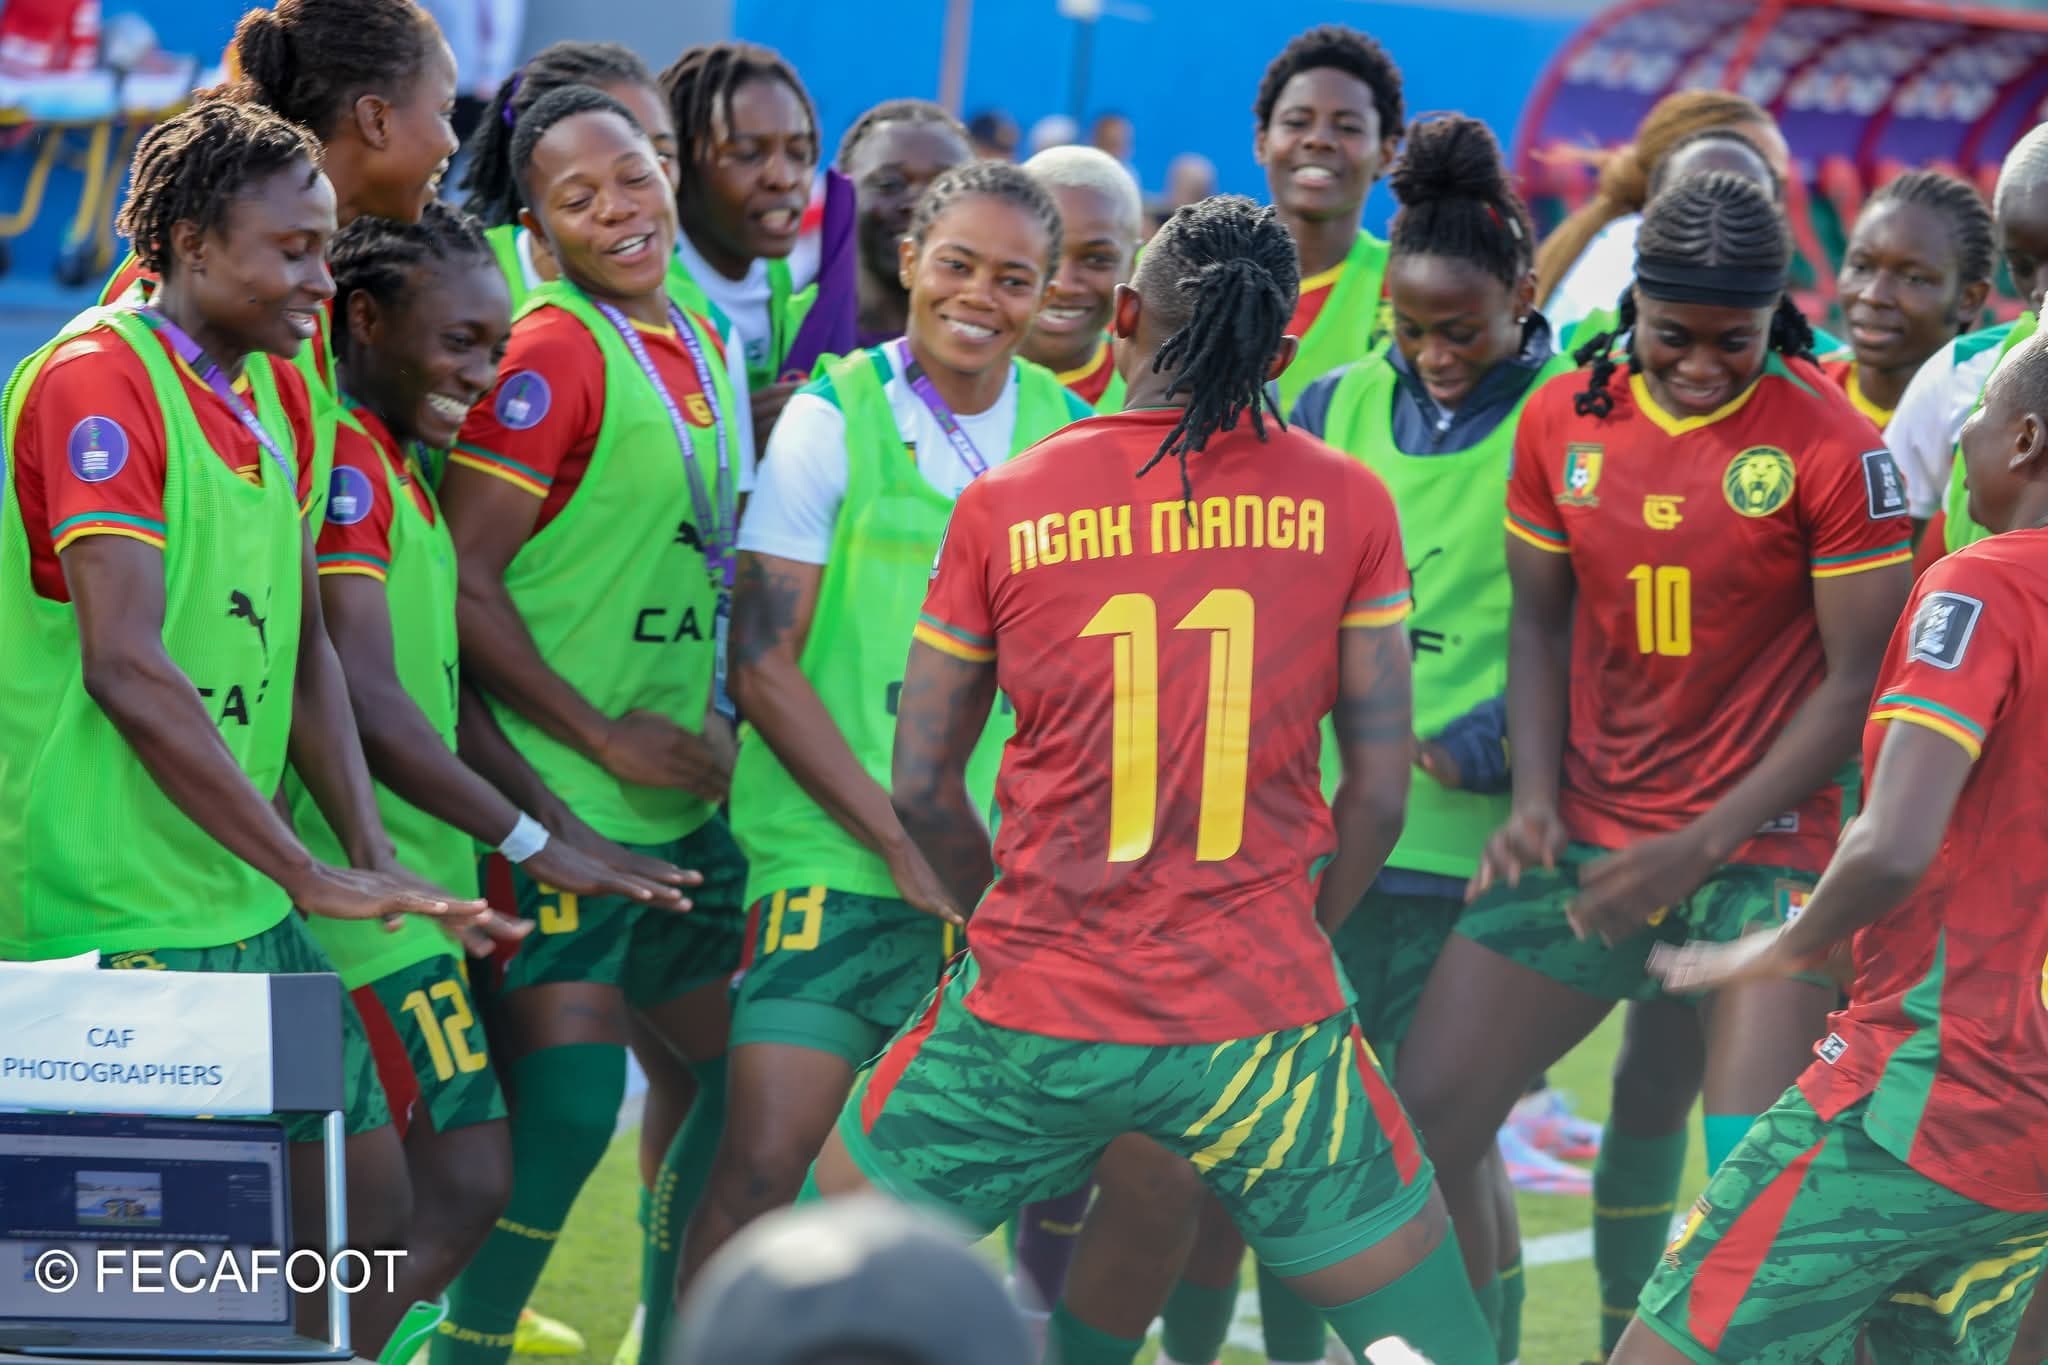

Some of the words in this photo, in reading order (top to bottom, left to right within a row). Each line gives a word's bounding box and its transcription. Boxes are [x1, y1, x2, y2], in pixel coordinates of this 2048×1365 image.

[1151, 495, 1325, 555] MANGA
[1626, 563, 1691, 656] 10
[1078, 588, 1255, 863] 11
[763, 885, 828, 956] 13
[87, 1027, 136, 1049] CAF
[400, 979, 488, 1082] 12
[3, 1057, 223, 1086] PHOTOGRAPHERS
